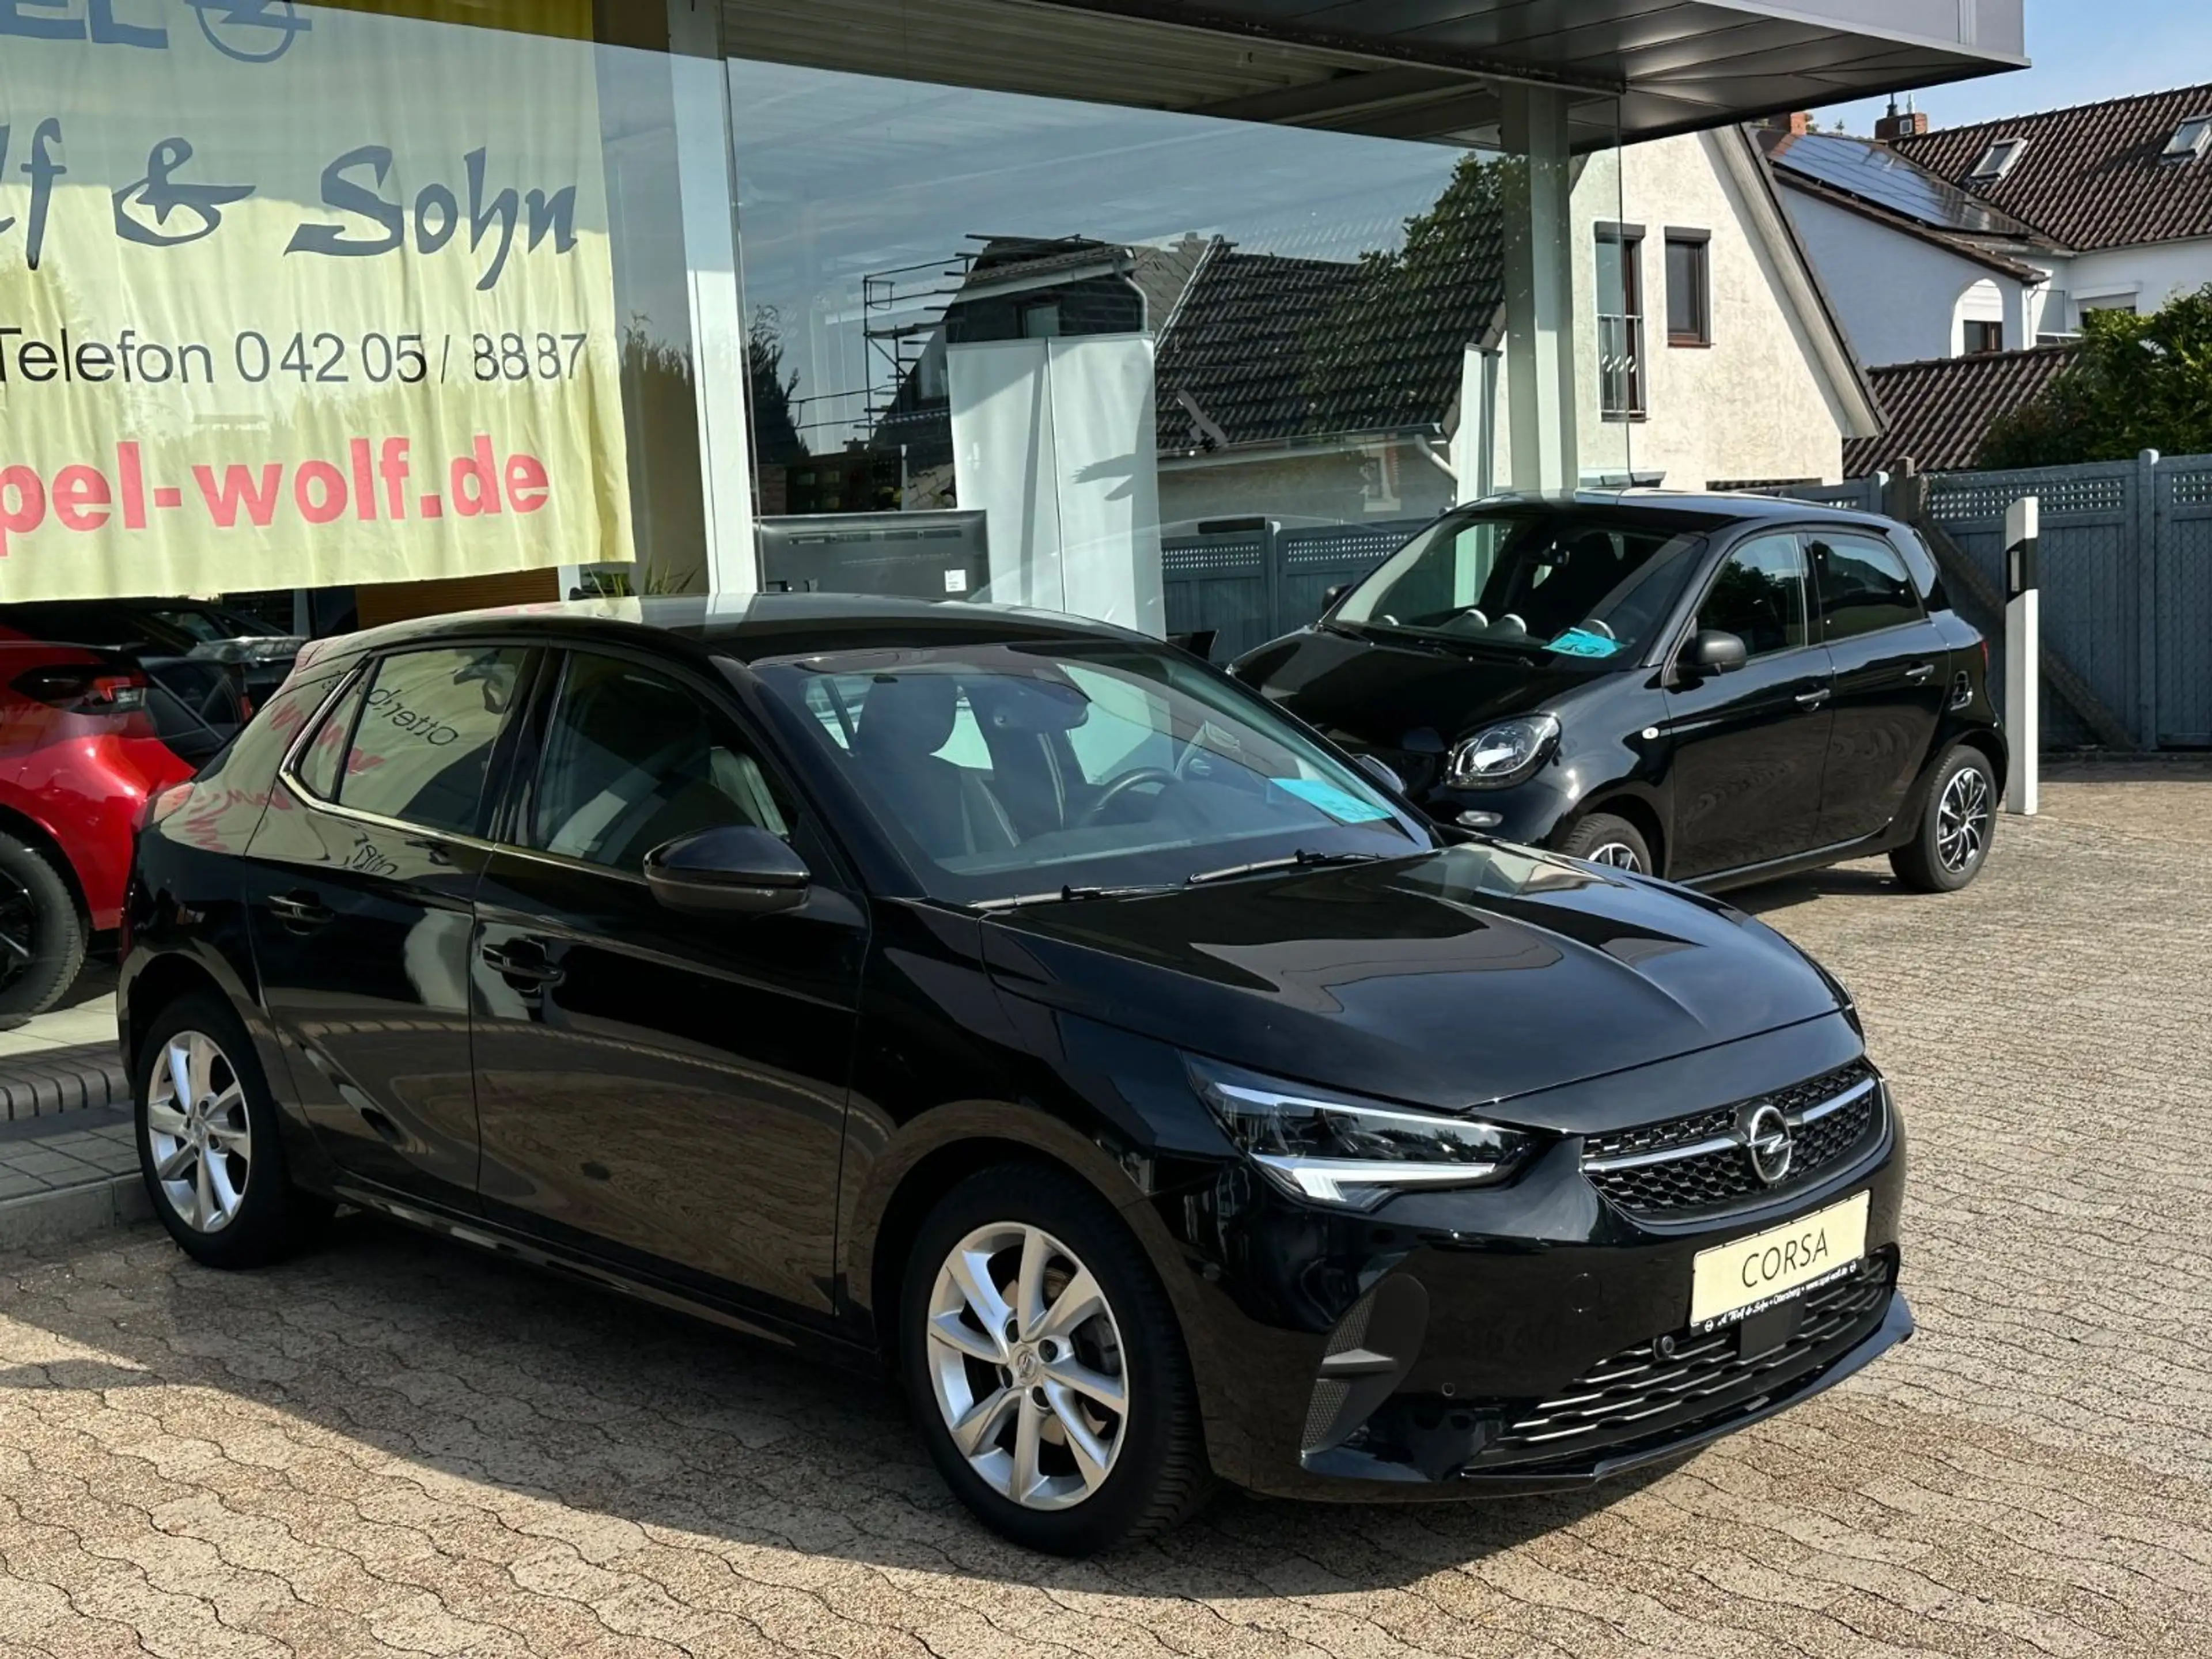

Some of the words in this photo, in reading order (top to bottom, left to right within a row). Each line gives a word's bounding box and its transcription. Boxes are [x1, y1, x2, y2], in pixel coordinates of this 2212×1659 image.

[112, 137, 256, 247] &
[283, 145, 578, 291] Sohn
[0, 328, 214, 382] Telefon
[0, 434, 549, 557] pel-wolf.de
[1741, 1227, 1828, 1288] CORSA
